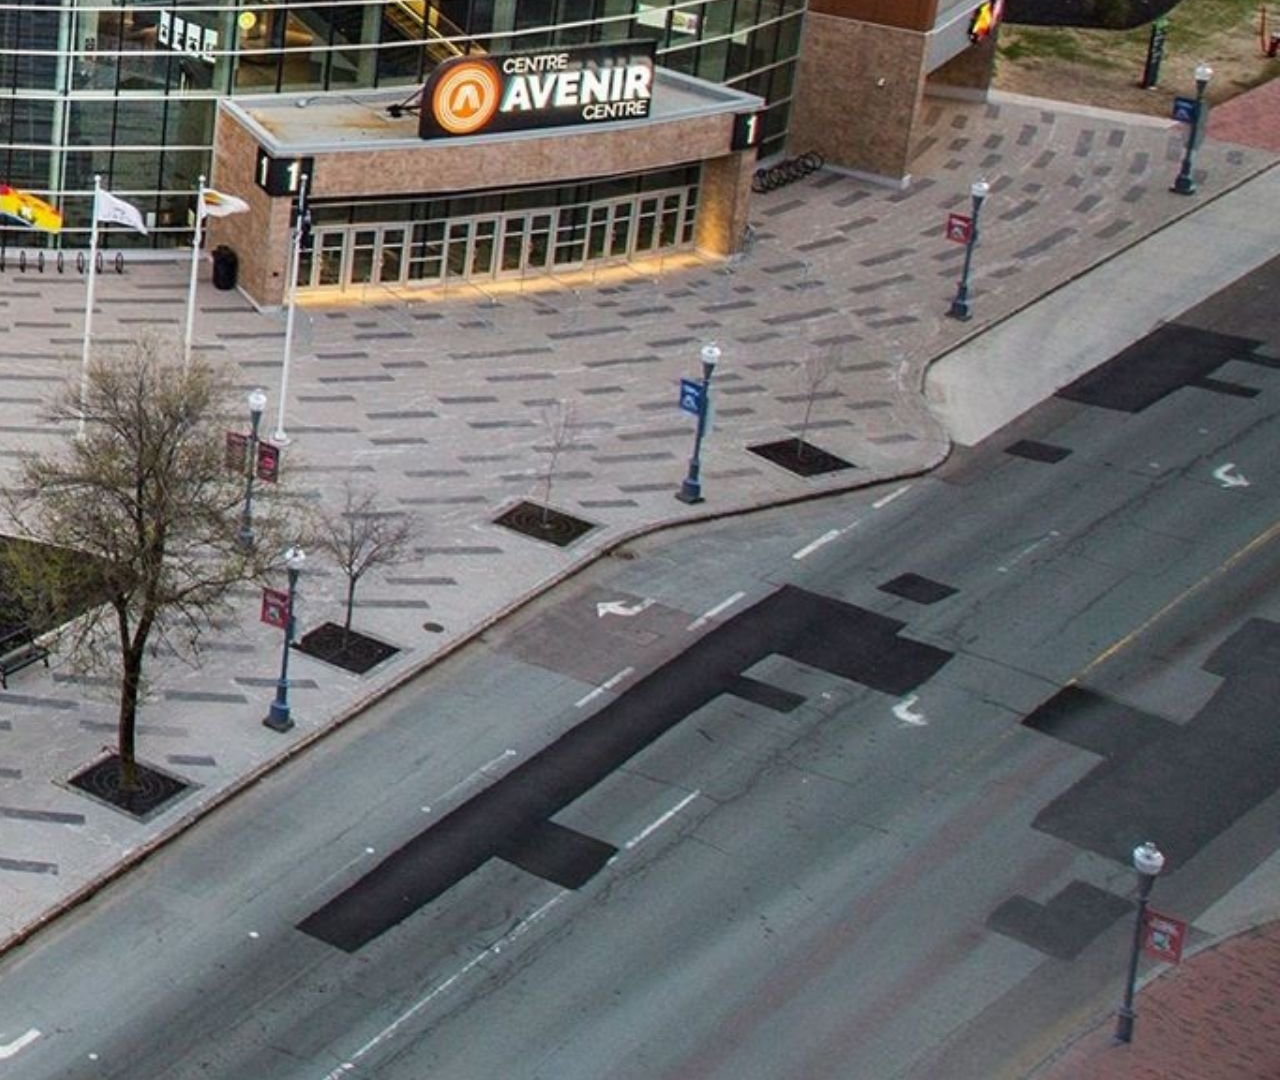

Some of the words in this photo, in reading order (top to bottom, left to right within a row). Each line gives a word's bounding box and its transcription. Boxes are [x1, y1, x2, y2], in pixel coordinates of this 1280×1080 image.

[503, 53, 569, 74] CENTRE
[499, 65, 653, 112] AVENIR
[582, 99, 647, 121] CENTRE
[747, 115, 757, 145] 1
[287, 161, 299, 192] 1
